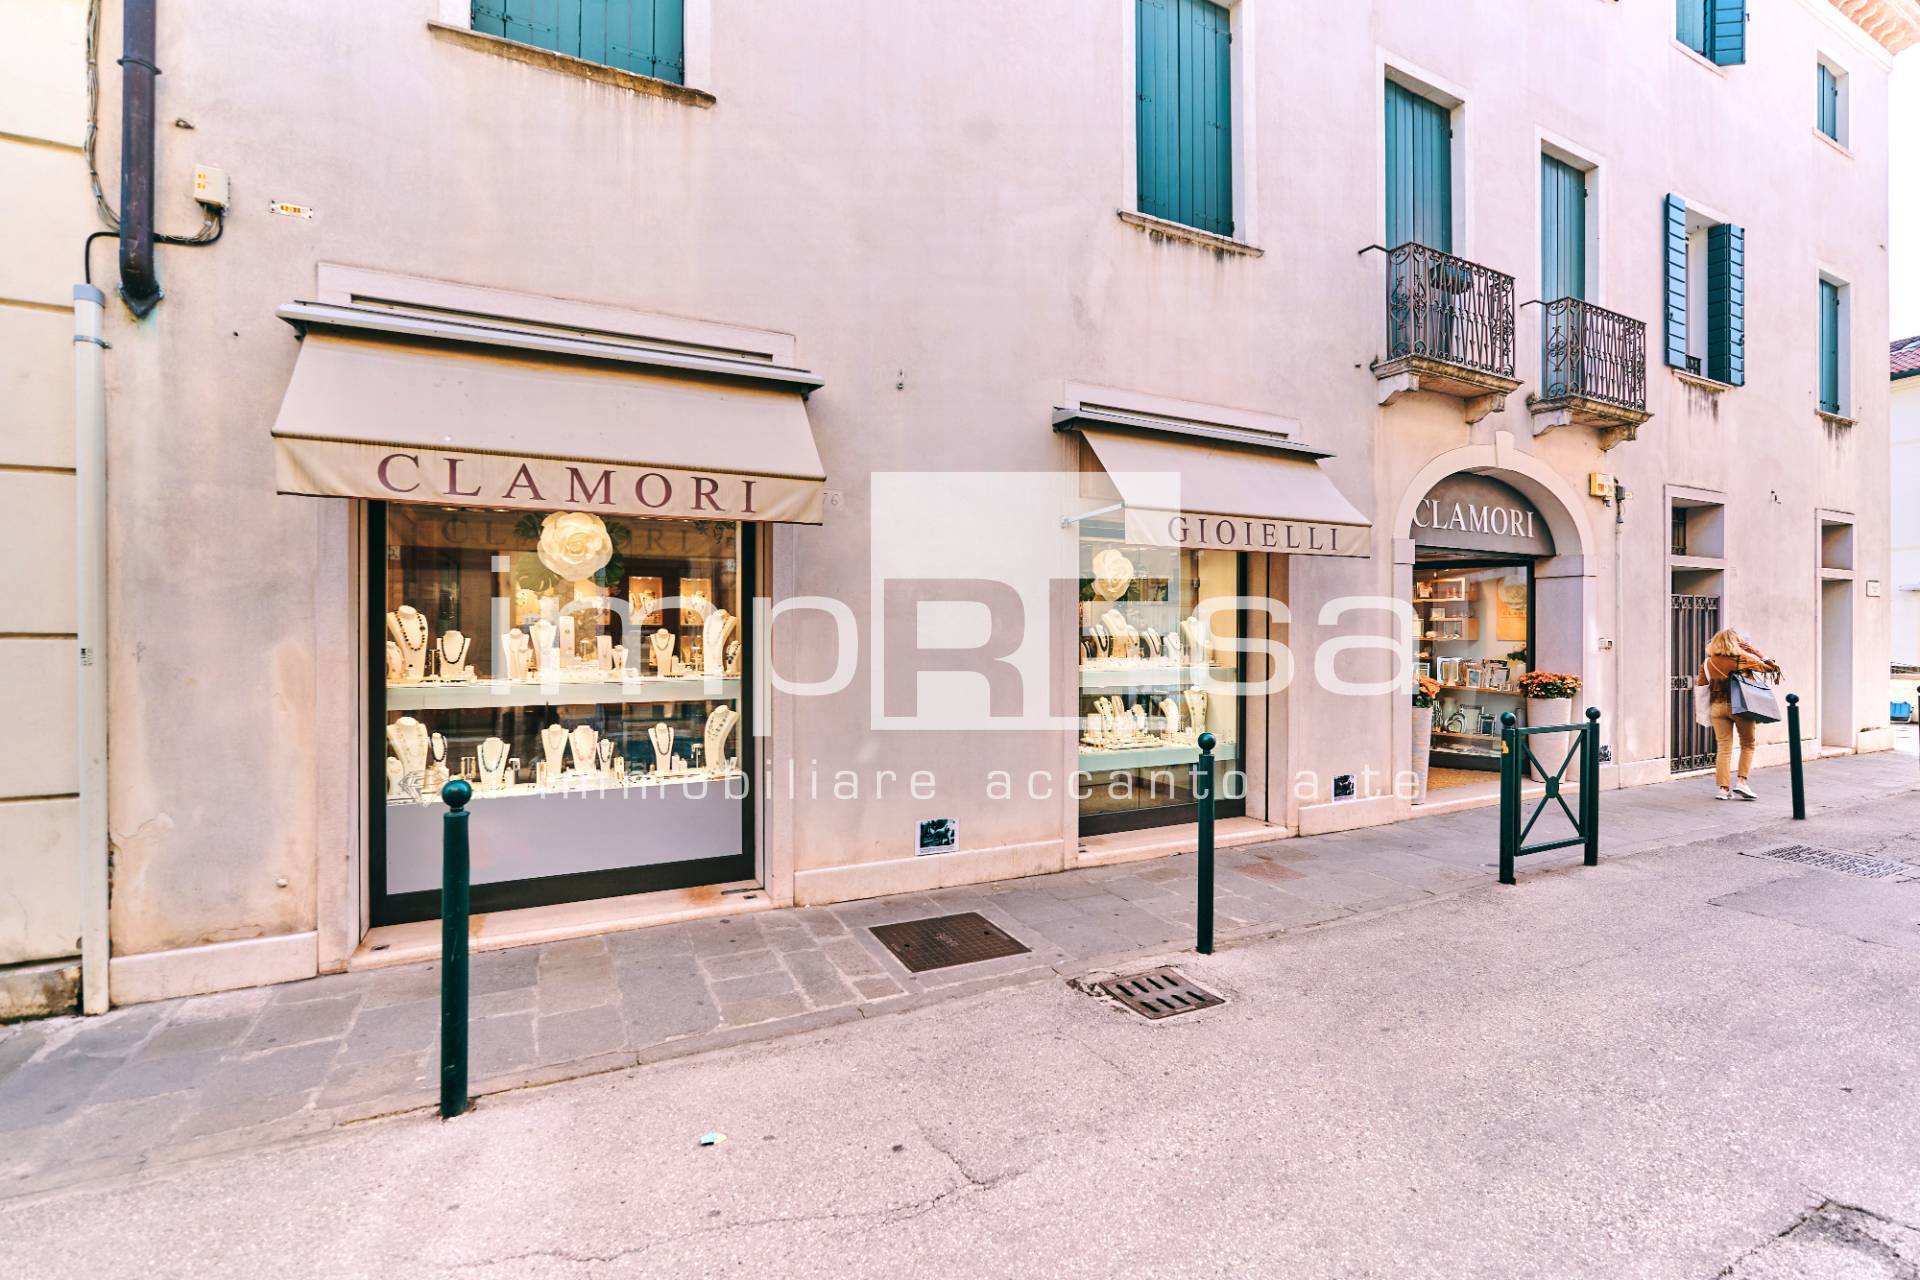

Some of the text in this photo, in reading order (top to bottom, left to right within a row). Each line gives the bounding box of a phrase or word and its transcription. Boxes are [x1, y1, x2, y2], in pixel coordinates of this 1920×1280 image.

[377, 453, 758, 513] CLAMORI
[1167, 516, 1338, 551] GIOIELLI
[1413, 498, 1535, 538] CLAMORI
